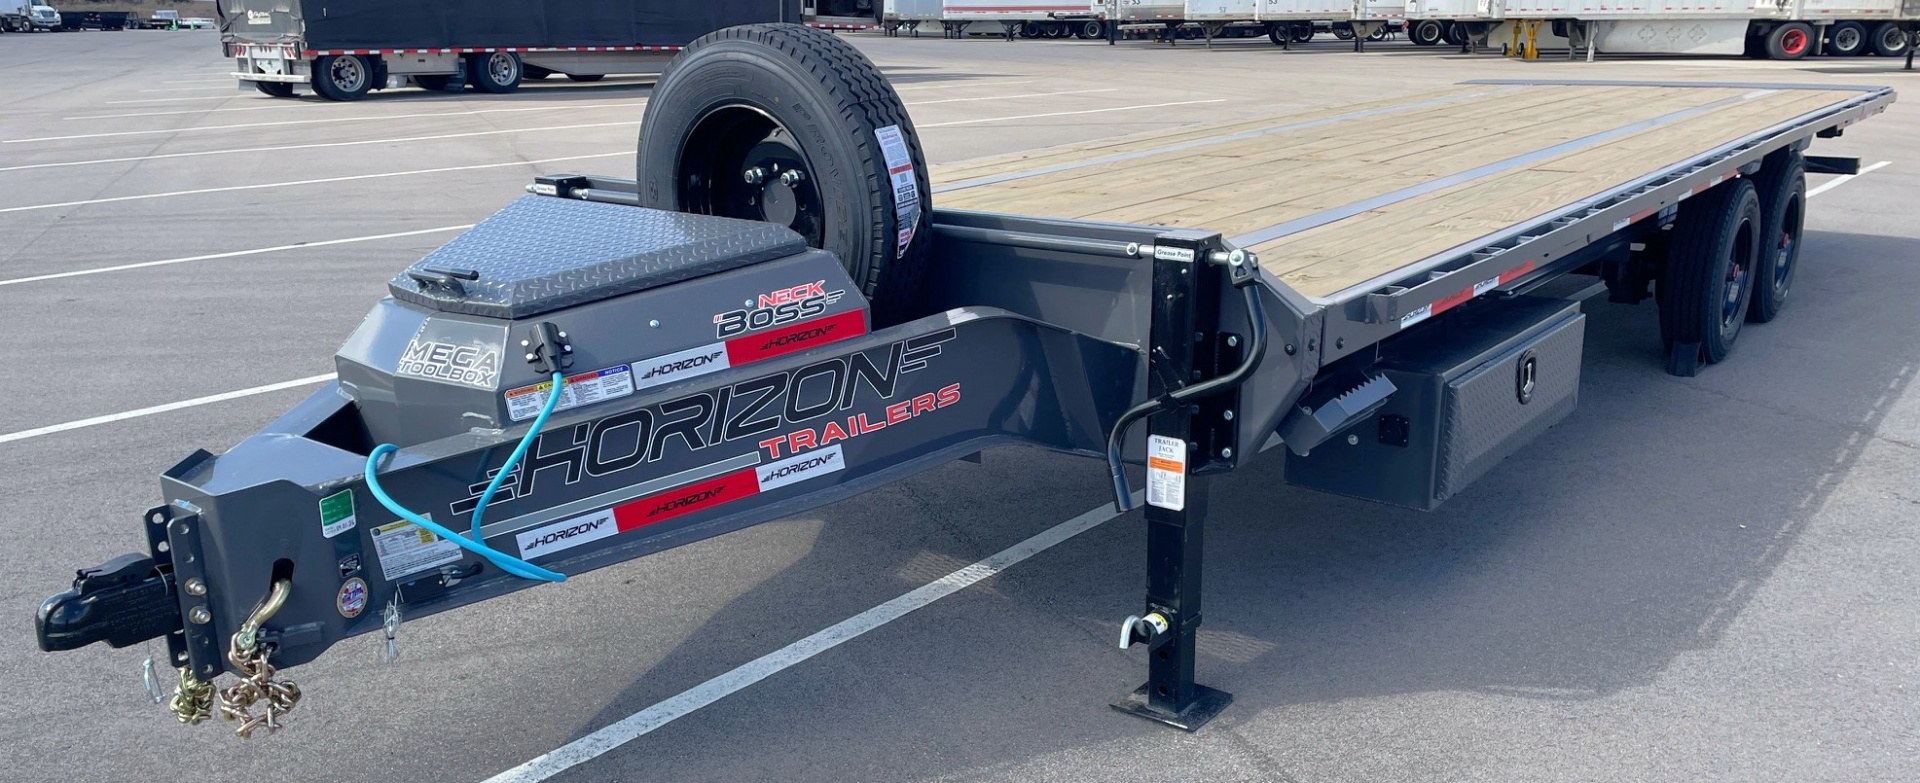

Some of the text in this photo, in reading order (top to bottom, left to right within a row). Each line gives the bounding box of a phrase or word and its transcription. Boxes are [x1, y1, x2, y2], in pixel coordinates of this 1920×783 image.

[1157, 248, 1192, 259] Grease Point
[758, 280, 826, 309] NECK
[716, 295, 826, 339] BOSS
[767, 326, 829, 349] HORIZON
[401, 340, 497, 375] MEGA
[604, 367, 624, 375] NOTICE
[650, 353, 716, 378] HORIZON
[398, 359, 494, 387] TOOLBOX
[516, 337, 906, 500] HORIZON
[758, 381, 962, 460] TRAILERS
[1153, 437, 1180, 447] TRAILER
[1158, 445, 1174, 454] JACK
[769, 454, 830, 482] HORIZON
[654, 486, 719, 515] HORIZON
[533, 519, 600, 548] HORIZON
